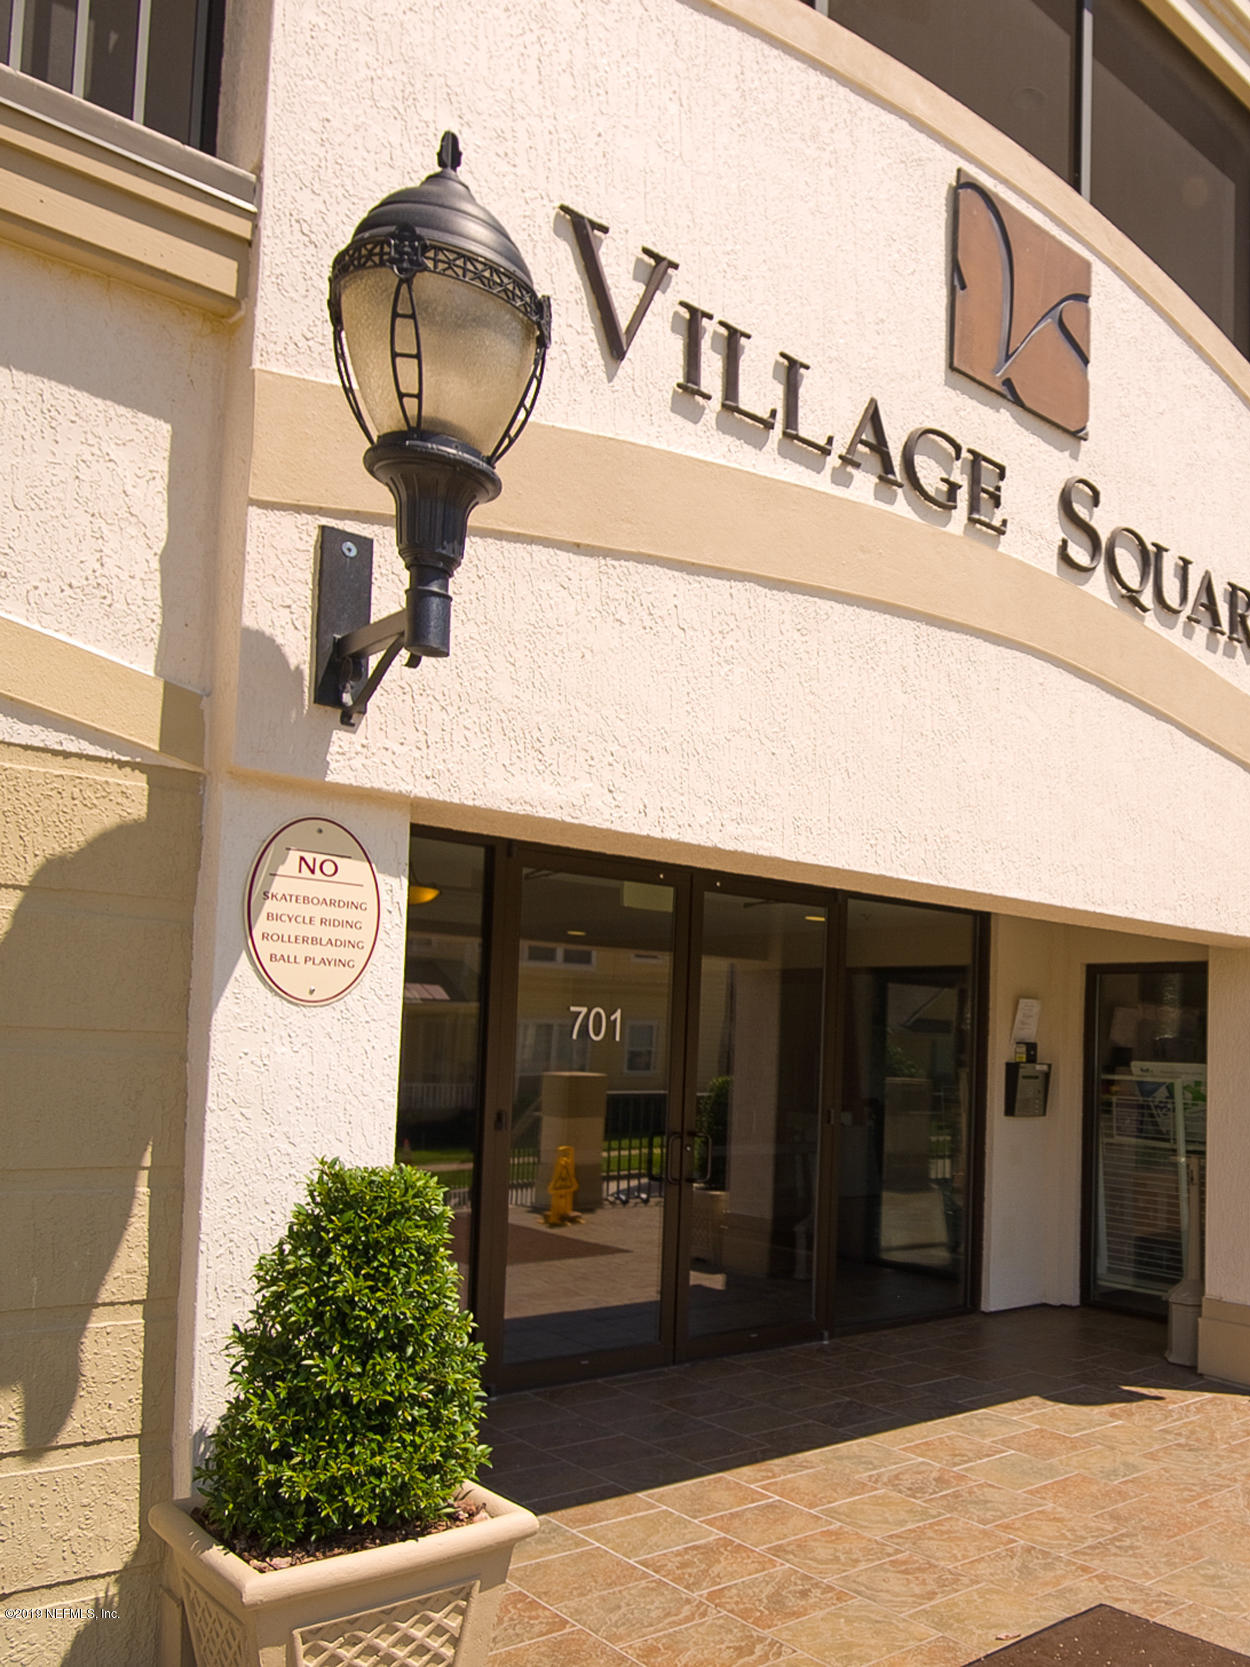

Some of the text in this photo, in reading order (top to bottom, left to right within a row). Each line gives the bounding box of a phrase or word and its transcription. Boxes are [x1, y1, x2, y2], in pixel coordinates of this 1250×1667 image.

[558, 203, 1008, 536] VILLAGE
[298, 855, 339, 877] NO
[263, 890, 368, 912] SKATEBOARDING
[266, 912, 363, 930] BICYCLE RIDING
[261, 932, 365, 950] ROLLERBLADING
[269, 953, 356, 969] BALL PLAYING
[569, 1006, 622, 1042] 701
